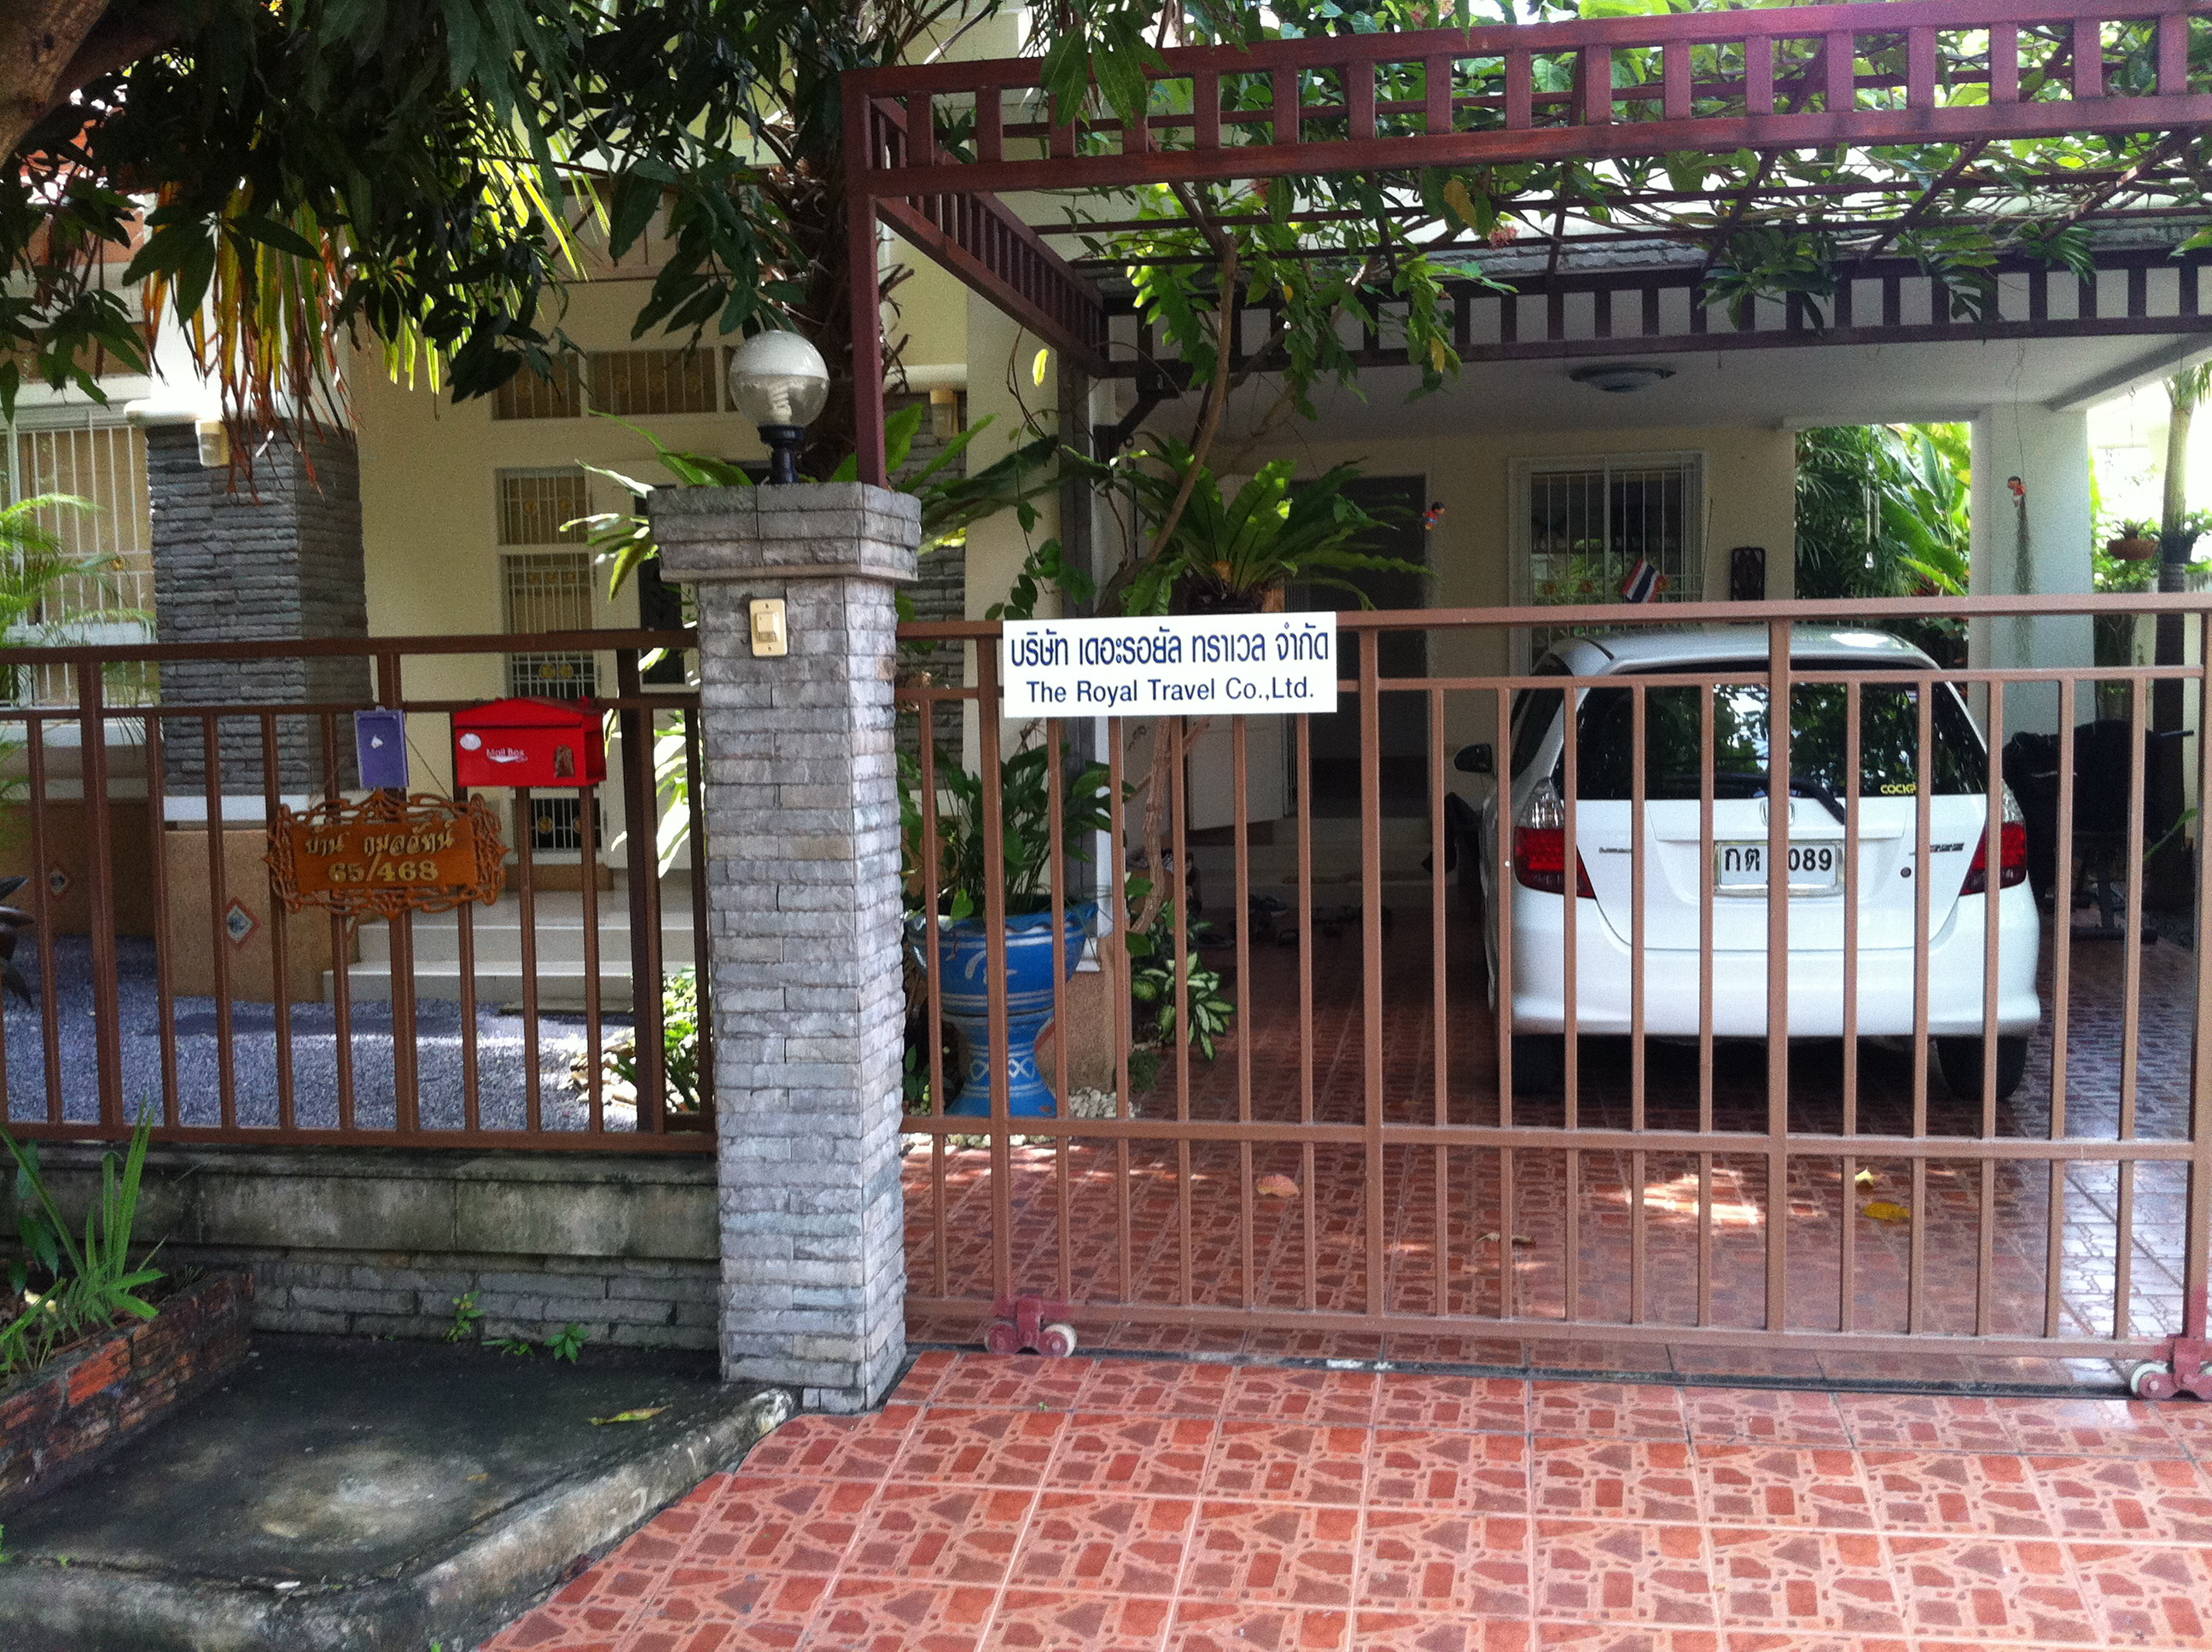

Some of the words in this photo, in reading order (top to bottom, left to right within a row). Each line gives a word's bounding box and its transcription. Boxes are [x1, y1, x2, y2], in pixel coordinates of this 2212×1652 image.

[1010, 628, 1069, 667] บริษัท
[1078, 625, 1182, 666] เดอะรอยัล
[1191, 634, 1266, 664] ทราเวล
[1275, 621, 1329, 662] จำกัด
[1026, 679, 1067, 703] The
[1077, 678, 1138, 708] Royal
[1147, 678, 1215, 702] Travel
[1225, 676, 1315, 701] Co.,Ltd.
[328, 854, 439, 883] 65/468
[1725, 847, 1761, 872] กต
[1787, 847, 1833, 872] 089
